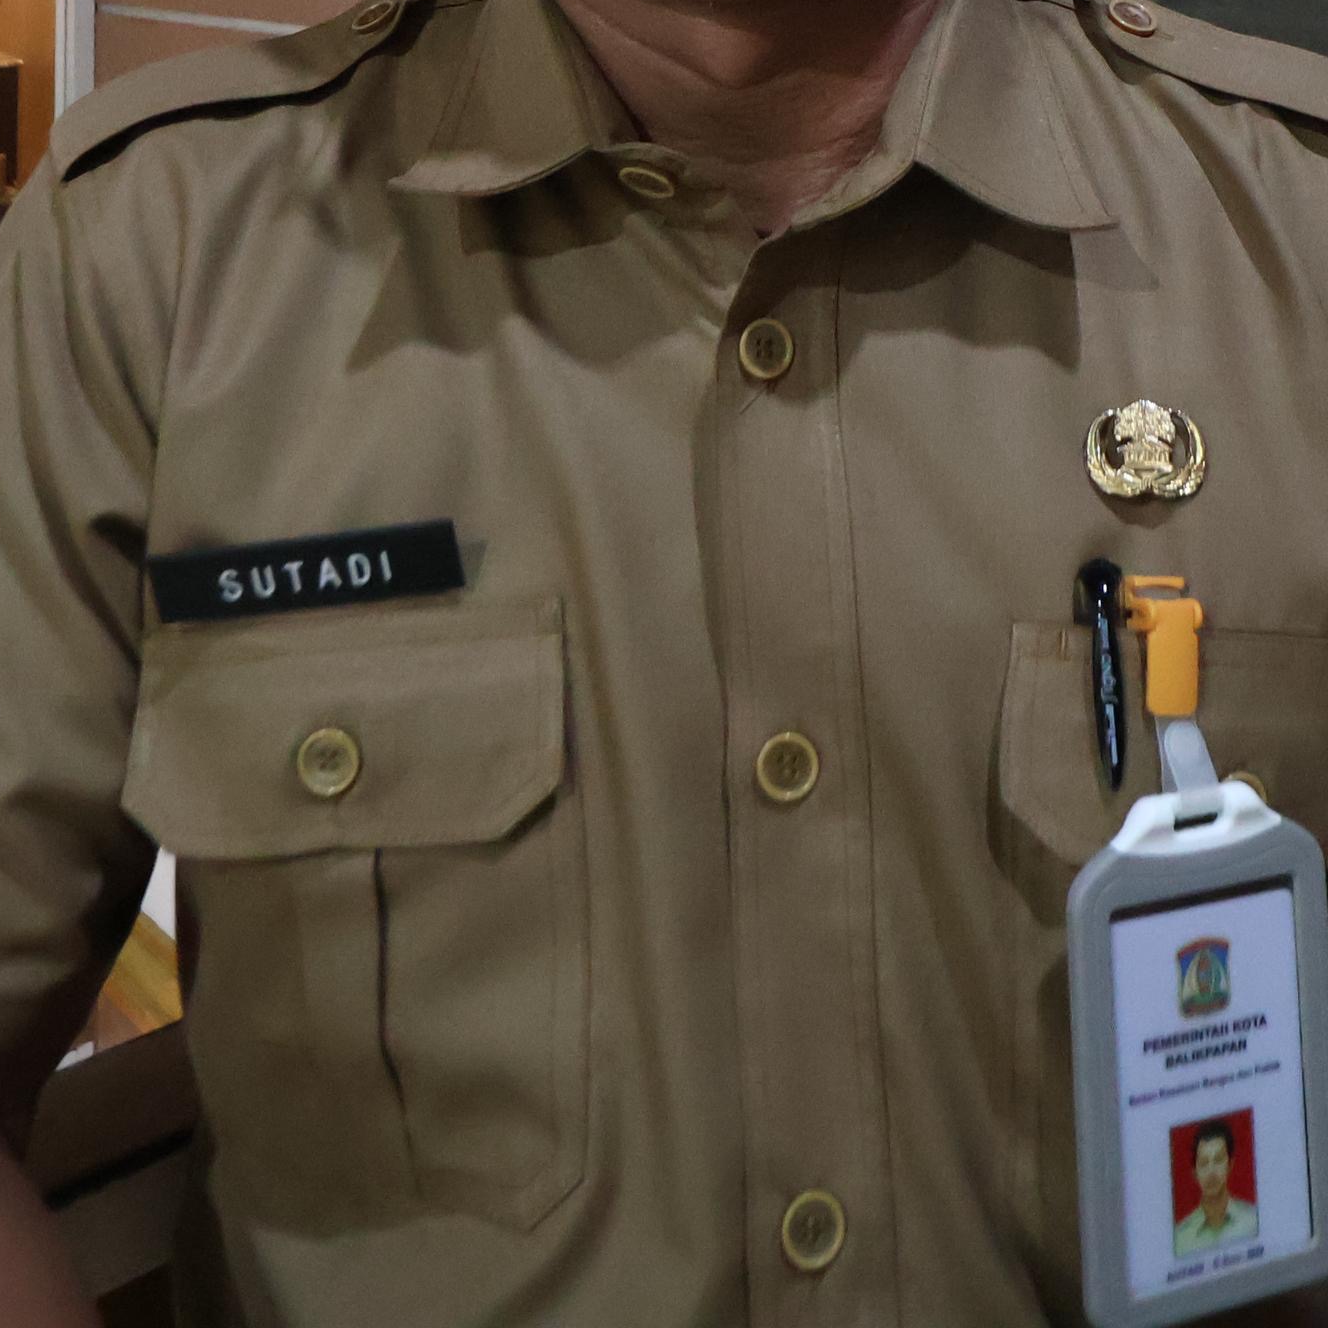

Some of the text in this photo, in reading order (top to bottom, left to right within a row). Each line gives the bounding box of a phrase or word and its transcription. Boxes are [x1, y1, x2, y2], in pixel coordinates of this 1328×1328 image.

[216, 549, 392, 603] SUTADI
[1142, 1013, 1267, 1053] PEMERINTAH KOTA
[1165, 1038, 1247, 1069] BALIKPAPAN
